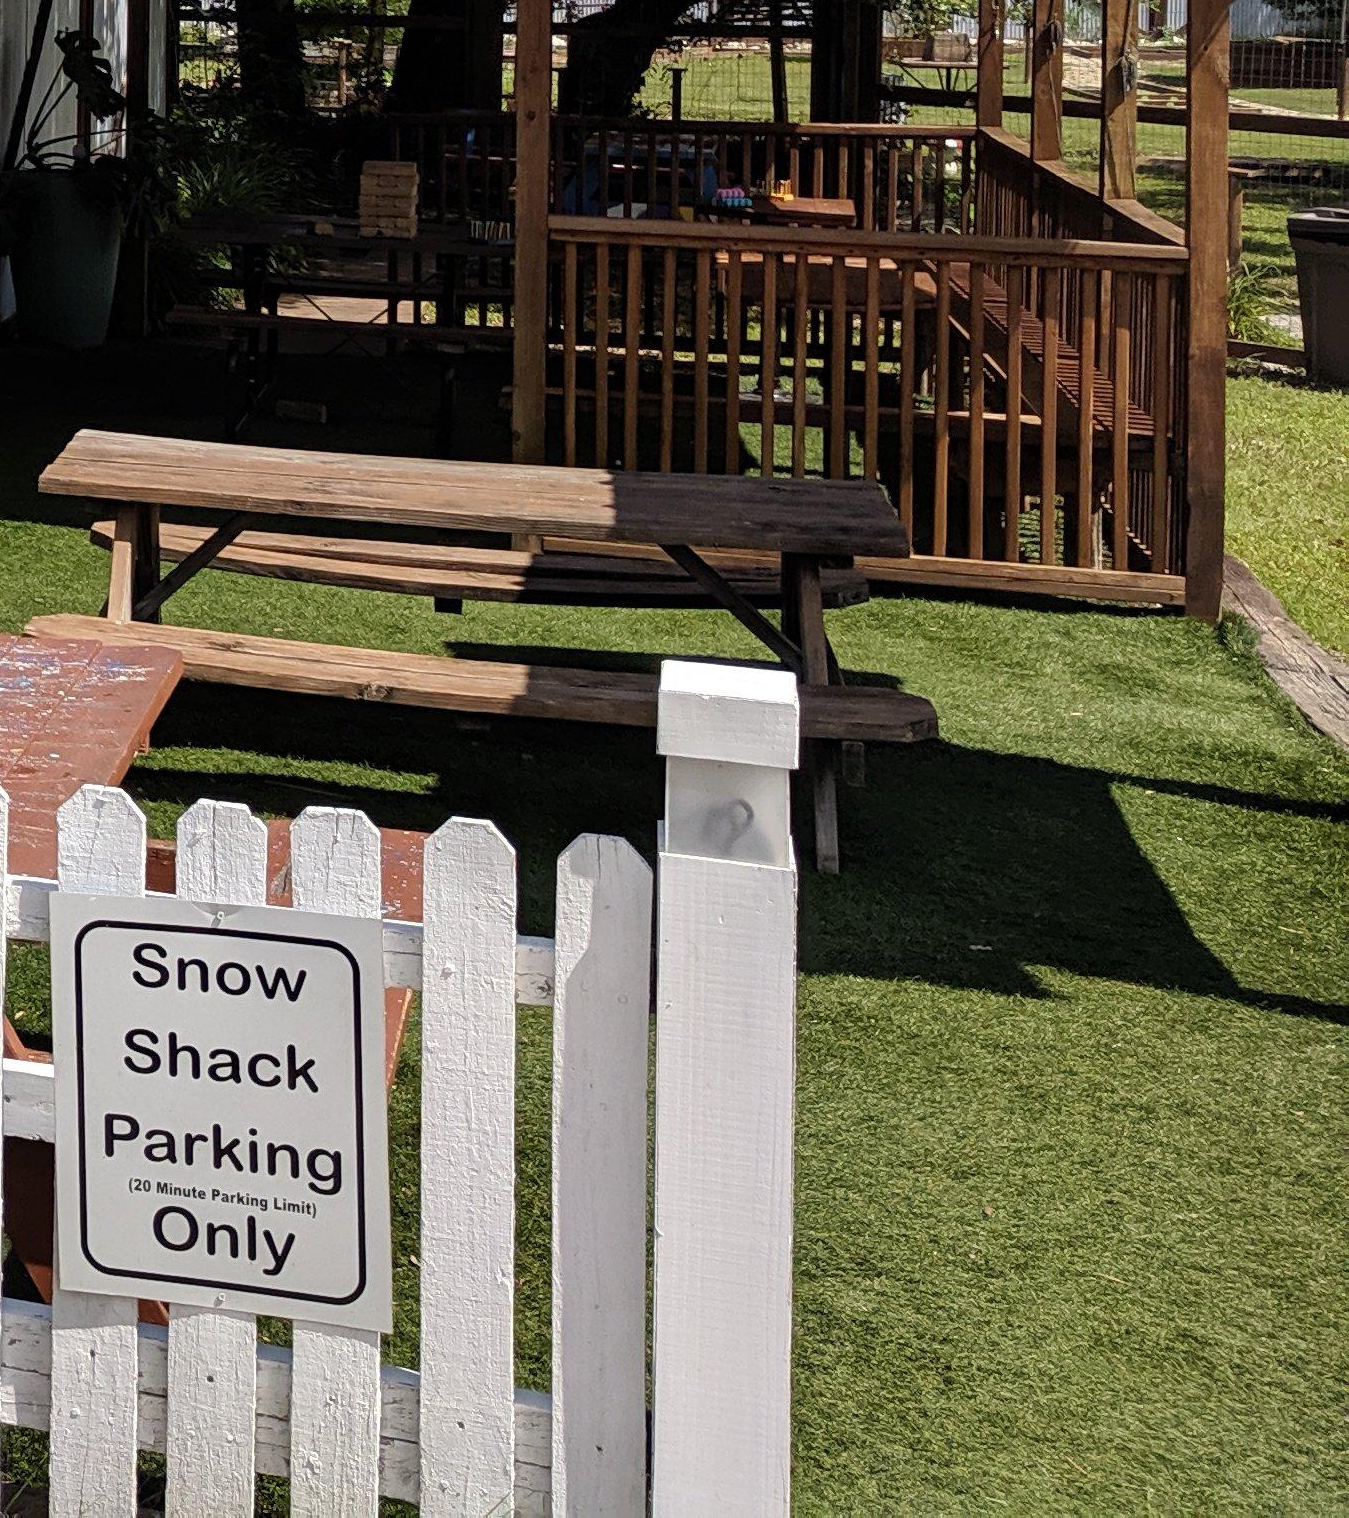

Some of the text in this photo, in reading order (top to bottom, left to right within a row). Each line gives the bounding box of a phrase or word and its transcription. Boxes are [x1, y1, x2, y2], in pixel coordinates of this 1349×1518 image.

[132, 942, 307, 1003] Snow
[123, 1028, 320, 1094] Shack
[103, 1113, 344, 1196] Parking
[128, 1178, 317, 1219] (20 Minute Parking Limit)
[152, 1205, 296, 1276] Only
